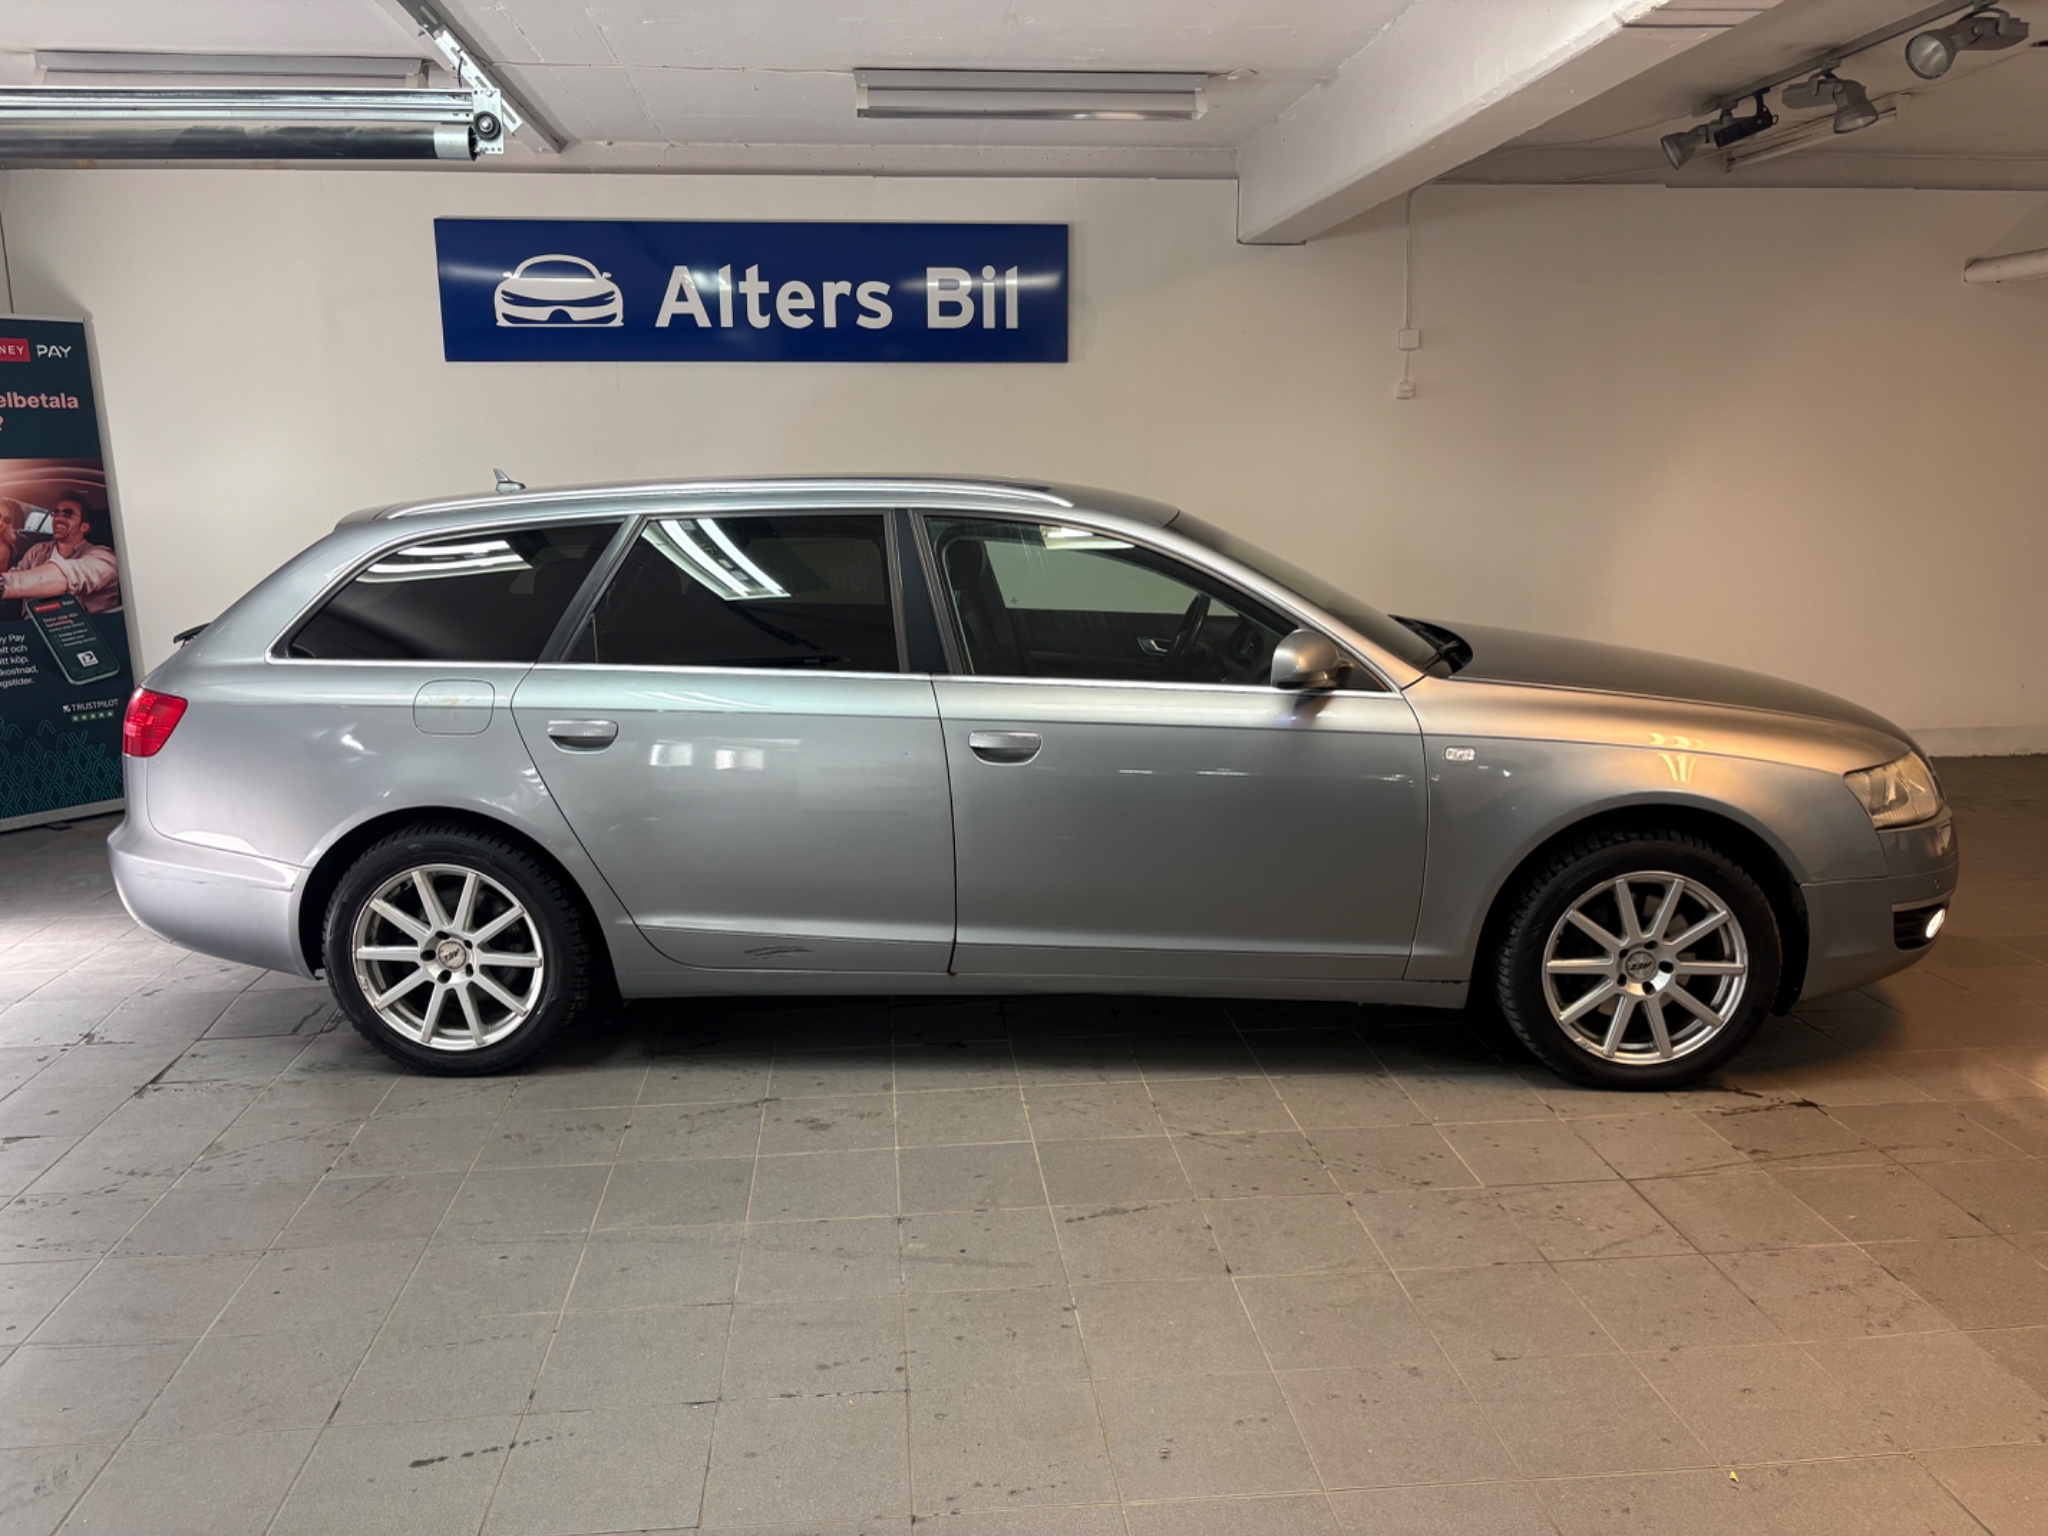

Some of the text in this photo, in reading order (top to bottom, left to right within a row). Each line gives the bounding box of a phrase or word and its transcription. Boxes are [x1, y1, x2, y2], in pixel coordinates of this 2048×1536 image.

[655, 263, 1019, 329] Alters Bil
[36, 344, 72, 358] PAY
[8, 634, 25, 643] Pay
[10, 645, 28, 653] och
[71, 698, 119, 711] TRUSTPILOT
